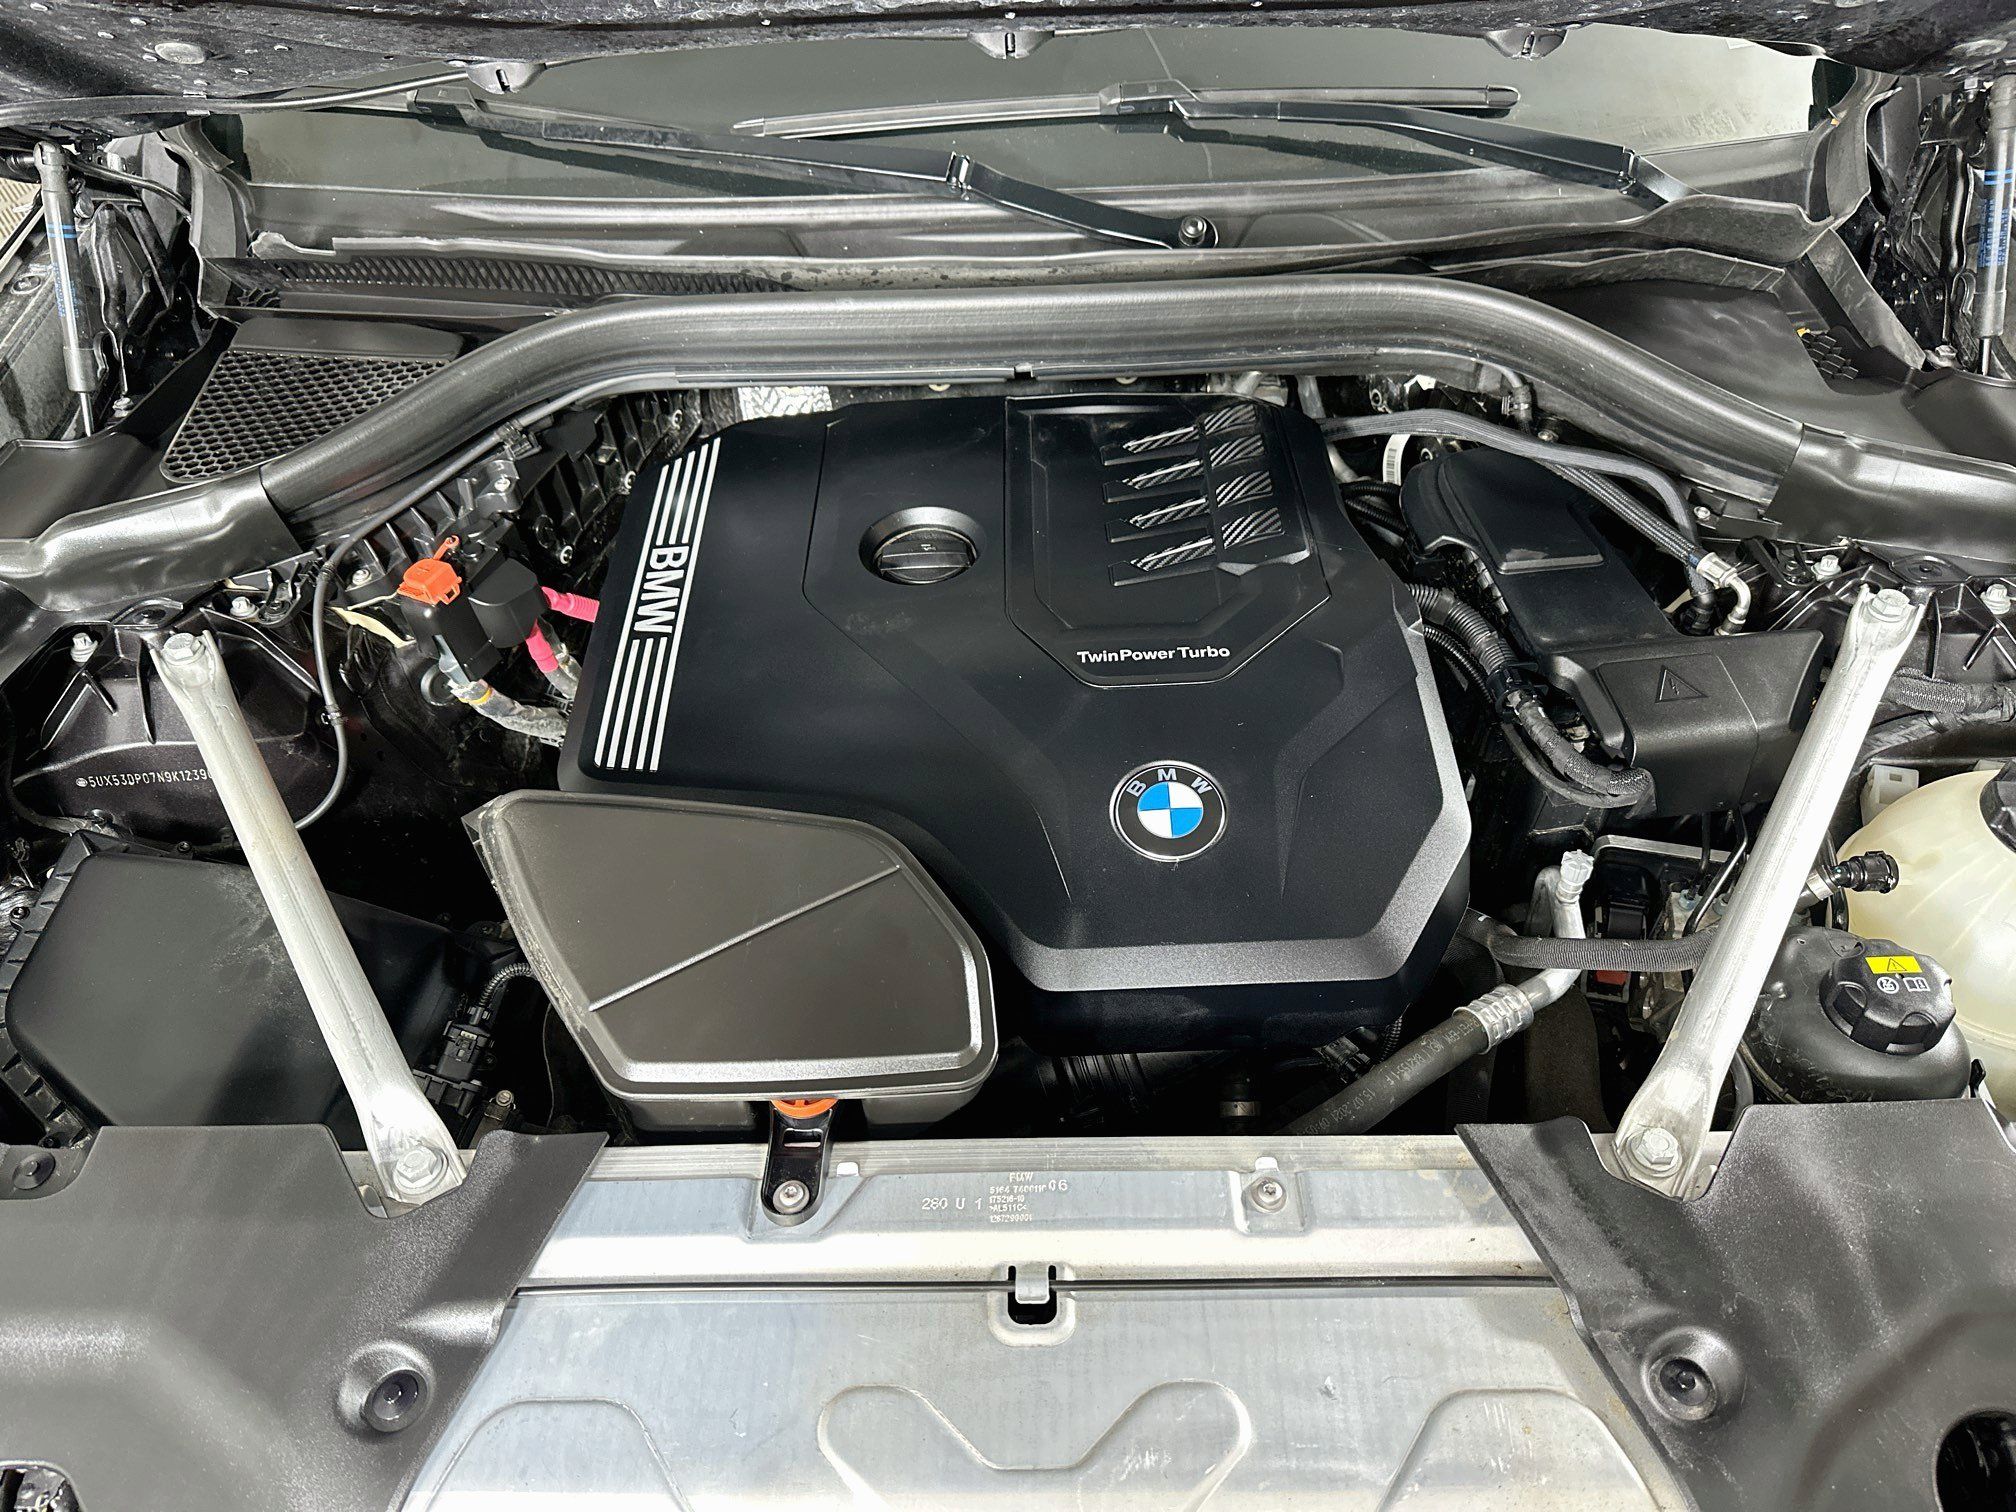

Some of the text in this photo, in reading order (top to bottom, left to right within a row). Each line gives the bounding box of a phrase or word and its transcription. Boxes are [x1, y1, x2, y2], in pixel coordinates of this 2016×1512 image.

[633, 545, 690, 634] BMW
[1077, 646, 1231, 663] TwinPower Turbo
[1126, 768, 1213, 797] BMW
[1049, 1180, 1068, 1192] 06
[955, 1197, 966, 1210] U
[975, 1197, 983, 1210] 1
